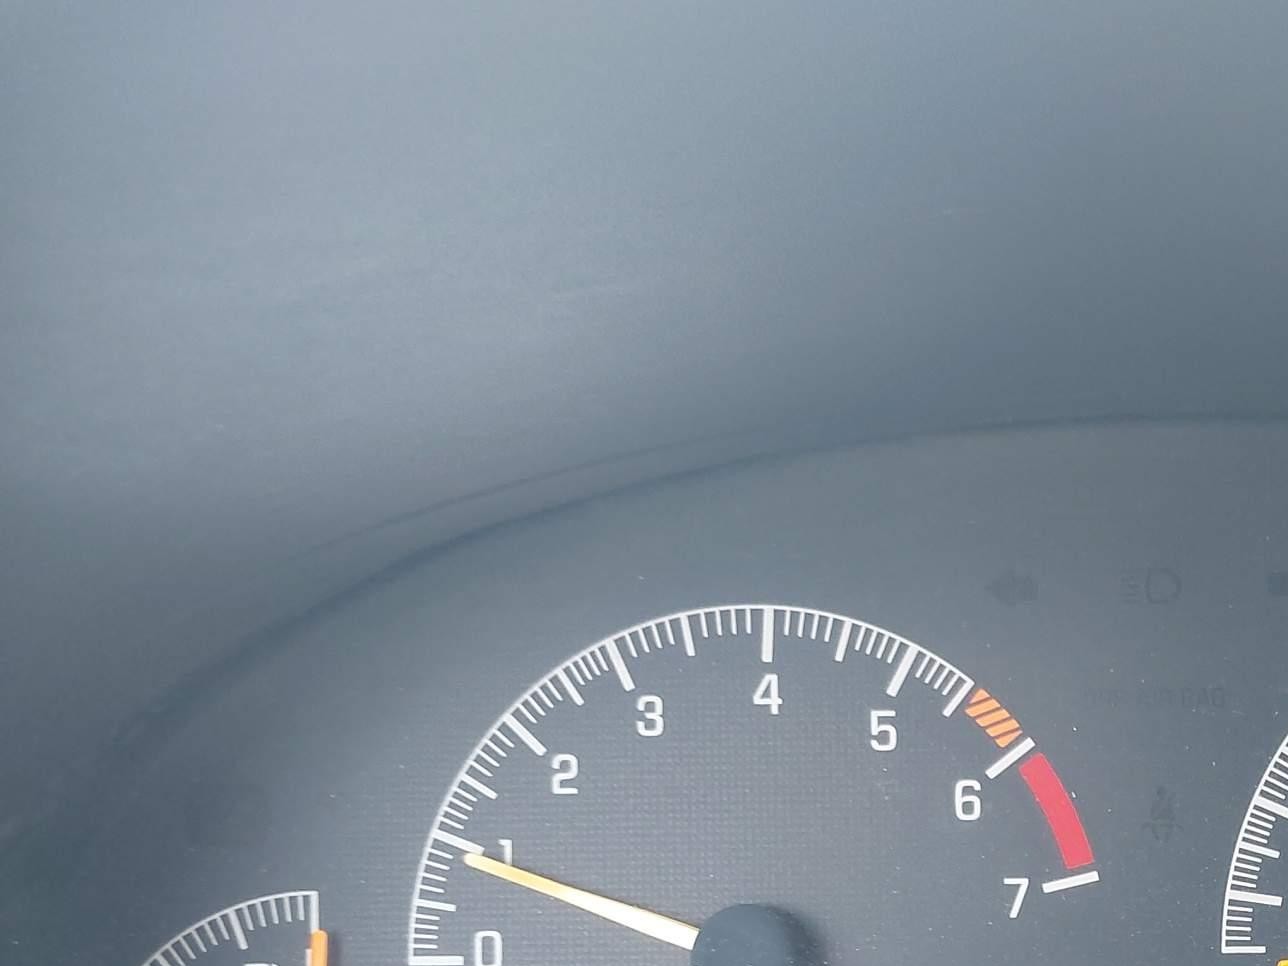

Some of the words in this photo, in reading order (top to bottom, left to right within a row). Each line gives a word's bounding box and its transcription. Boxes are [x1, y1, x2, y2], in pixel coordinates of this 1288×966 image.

[752, 673, 783, 715] 4
[636, 695, 664, 737] 3
[870, 710, 897, 751] 5
[551, 753, 578, 795] 2
[954, 779, 981, 821] 6
[498, 840, 514, 868] 1
[1003, 877, 1029, 919] 7
